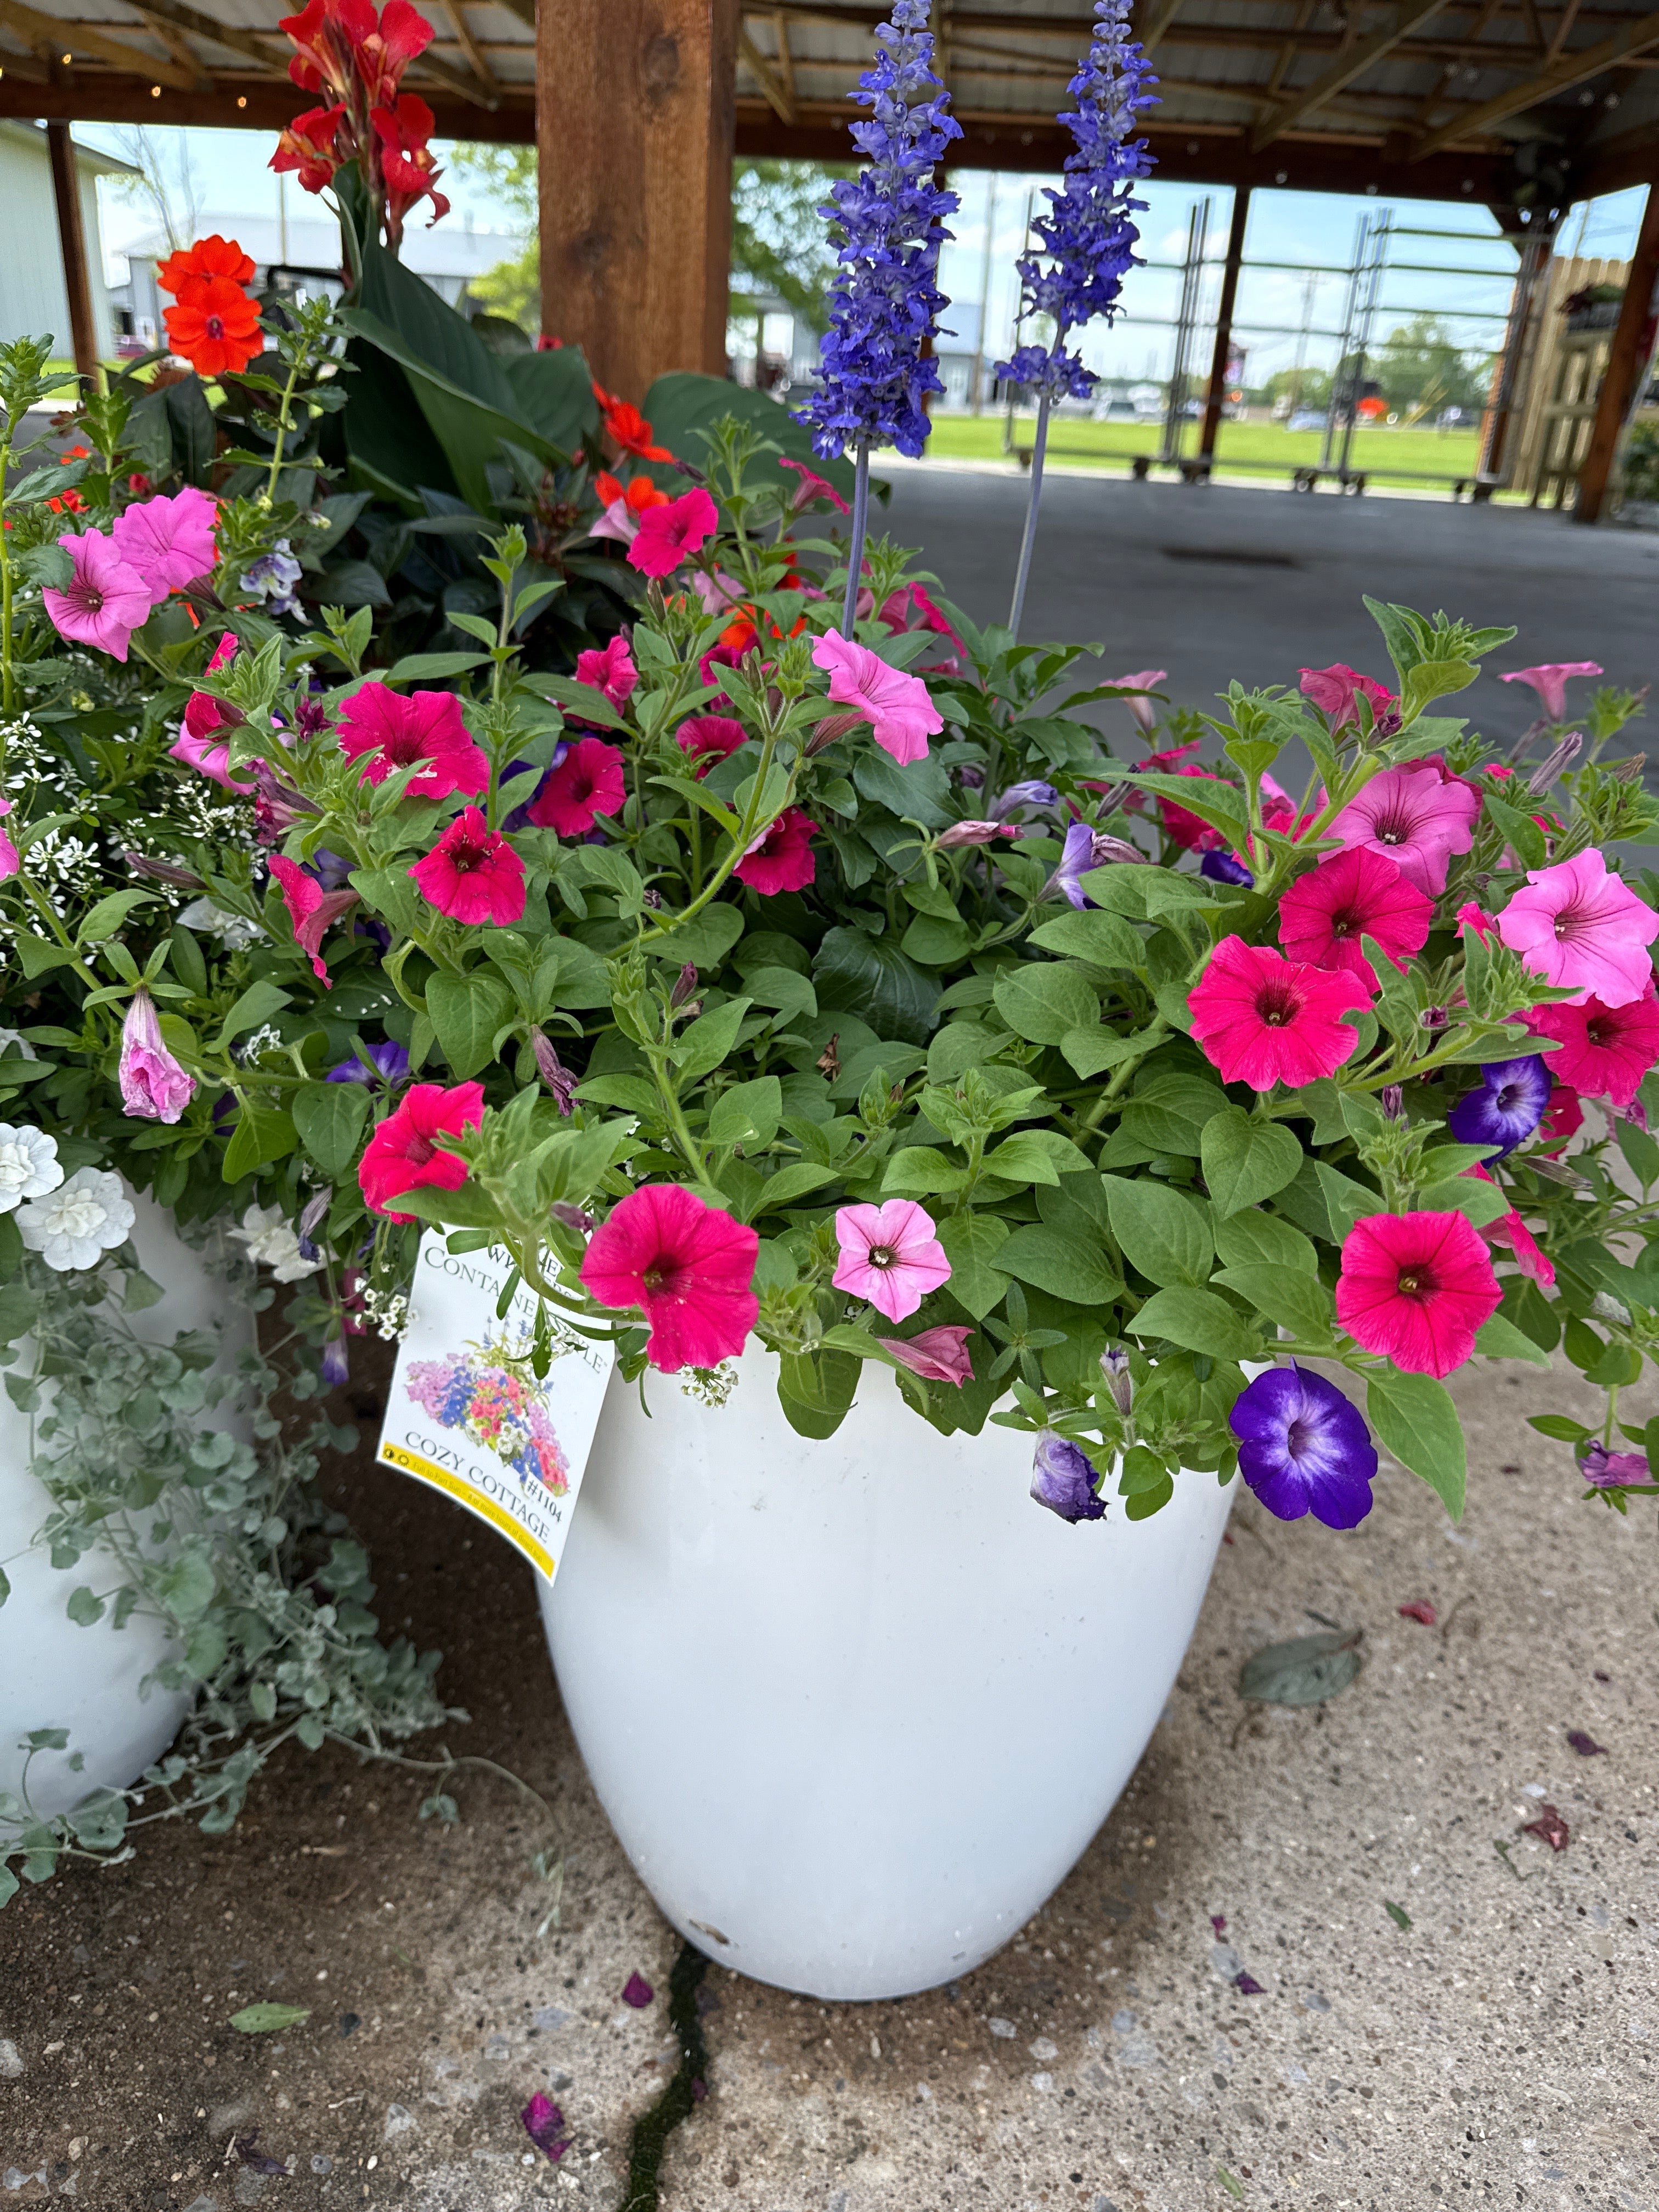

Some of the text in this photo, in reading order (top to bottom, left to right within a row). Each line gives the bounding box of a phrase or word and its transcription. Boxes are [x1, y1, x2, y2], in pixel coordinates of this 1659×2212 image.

[425, 1246, 542, 1321] CONTANE
[405, 1431, 550, 1544] COZY COTTAGE
[527, 1480, 562, 1522] #1104
